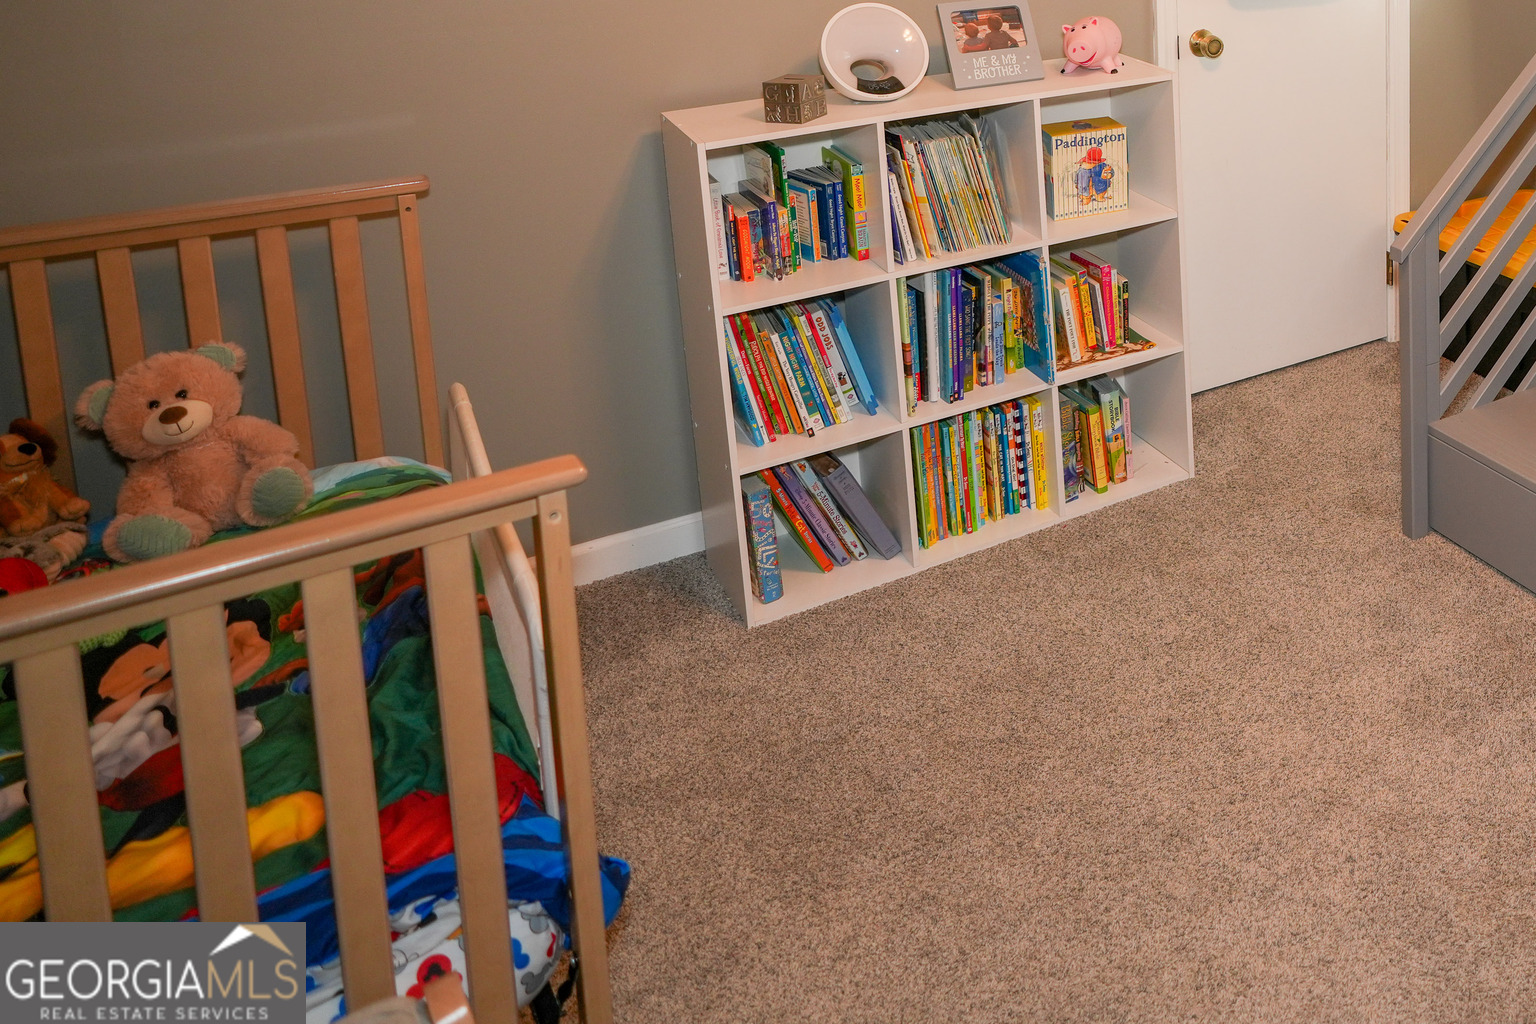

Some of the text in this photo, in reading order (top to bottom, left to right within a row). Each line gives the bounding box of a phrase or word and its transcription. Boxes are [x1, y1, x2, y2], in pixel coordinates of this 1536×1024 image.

[973, 53, 1016, 68] ME & MY
[974, 64, 1022, 79] BROTHER
[1055, 133, 1125, 149] Paddington
[815, 316, 827, 332] ODD
[821, 332, 834, 351] JOBS
[782, 336, 806, 388] NIGHT NIGHT FARM
[734, 367, 743, 385] WORLD
[1108, 400, 1116, 432] STORYBOOK
[1061, 405, 1073, 465] Bible Stories
[816, 491, 834, 515] 5-Minute
[833, 514, 848, 534] Stories
[795, 519, 803, 533] Cat
[825, 534, 836, 550] Stories
